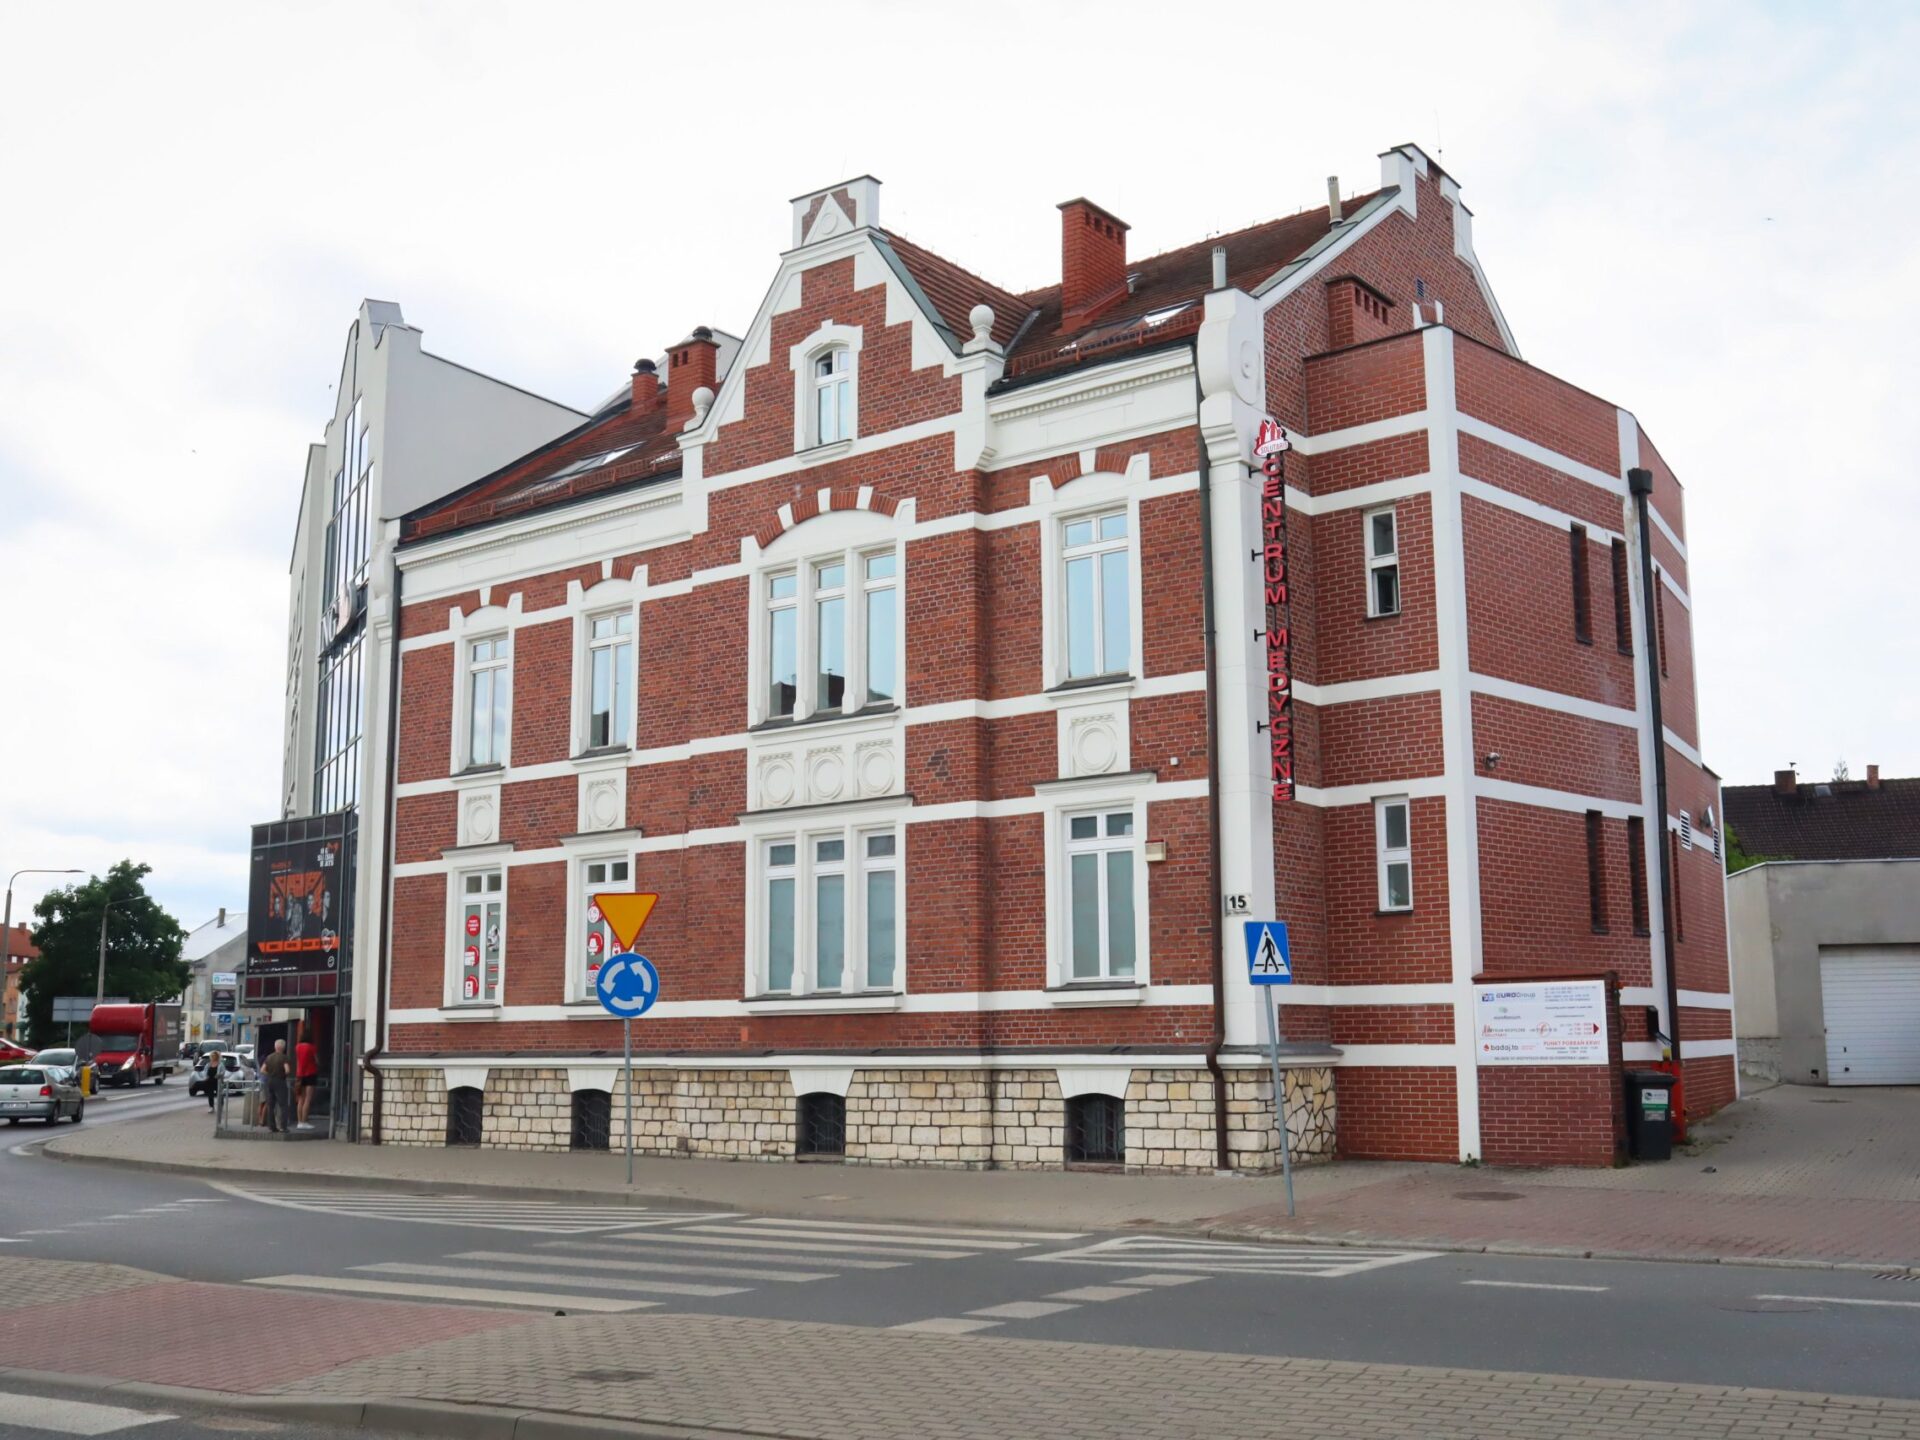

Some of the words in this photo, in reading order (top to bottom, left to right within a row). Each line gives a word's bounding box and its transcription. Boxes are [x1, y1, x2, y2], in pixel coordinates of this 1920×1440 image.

[1262, 458, 1287, 605] CENTRUM
[1265, 628, 1291, 801] MEDYCZNE
[1229, 895, 1246, 909] 15
